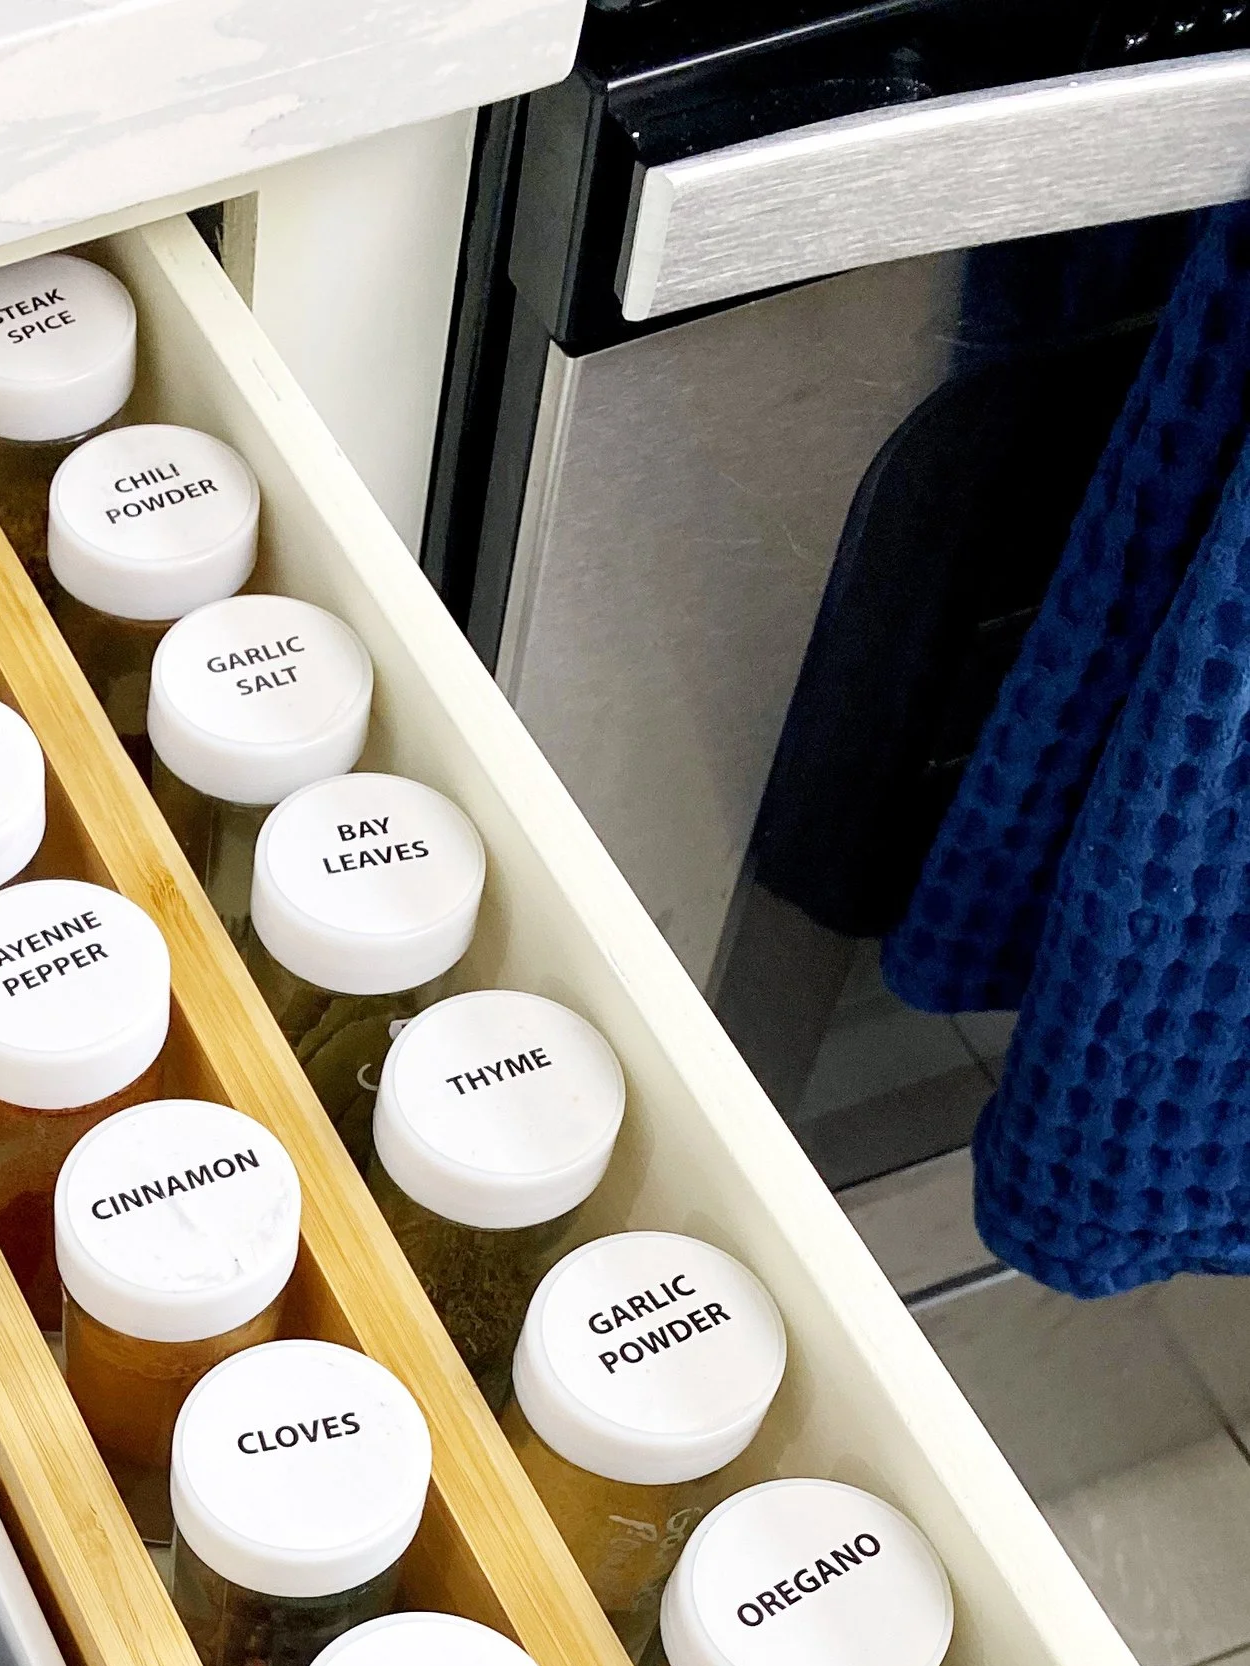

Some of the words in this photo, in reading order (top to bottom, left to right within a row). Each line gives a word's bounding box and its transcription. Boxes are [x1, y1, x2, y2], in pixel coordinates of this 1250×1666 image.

[7, 310, 75, 344] SPICE
[114, 463, 180, 493] CHILI
[105, 479, 219, 524] POWDER
[207, 636, 305, 673] GARLIC
[236, 665, 297, 696] SALT
[336, 816, 389, 842] BAY
[322, 840, 429, 874] LEAVES
[2, 943, 109, 997] PEPPER
[445, 1047, 552, 1095] THYME
[91, 1149, 260, 1220] CINNAMON
[588, 1274, 697, 1335] GARLIC
[597, 1302, 732, 1375] POWDER
[237, 1412, 361, 1455] CLOVES
[736, 1533, 881, 1627] OREGANO
